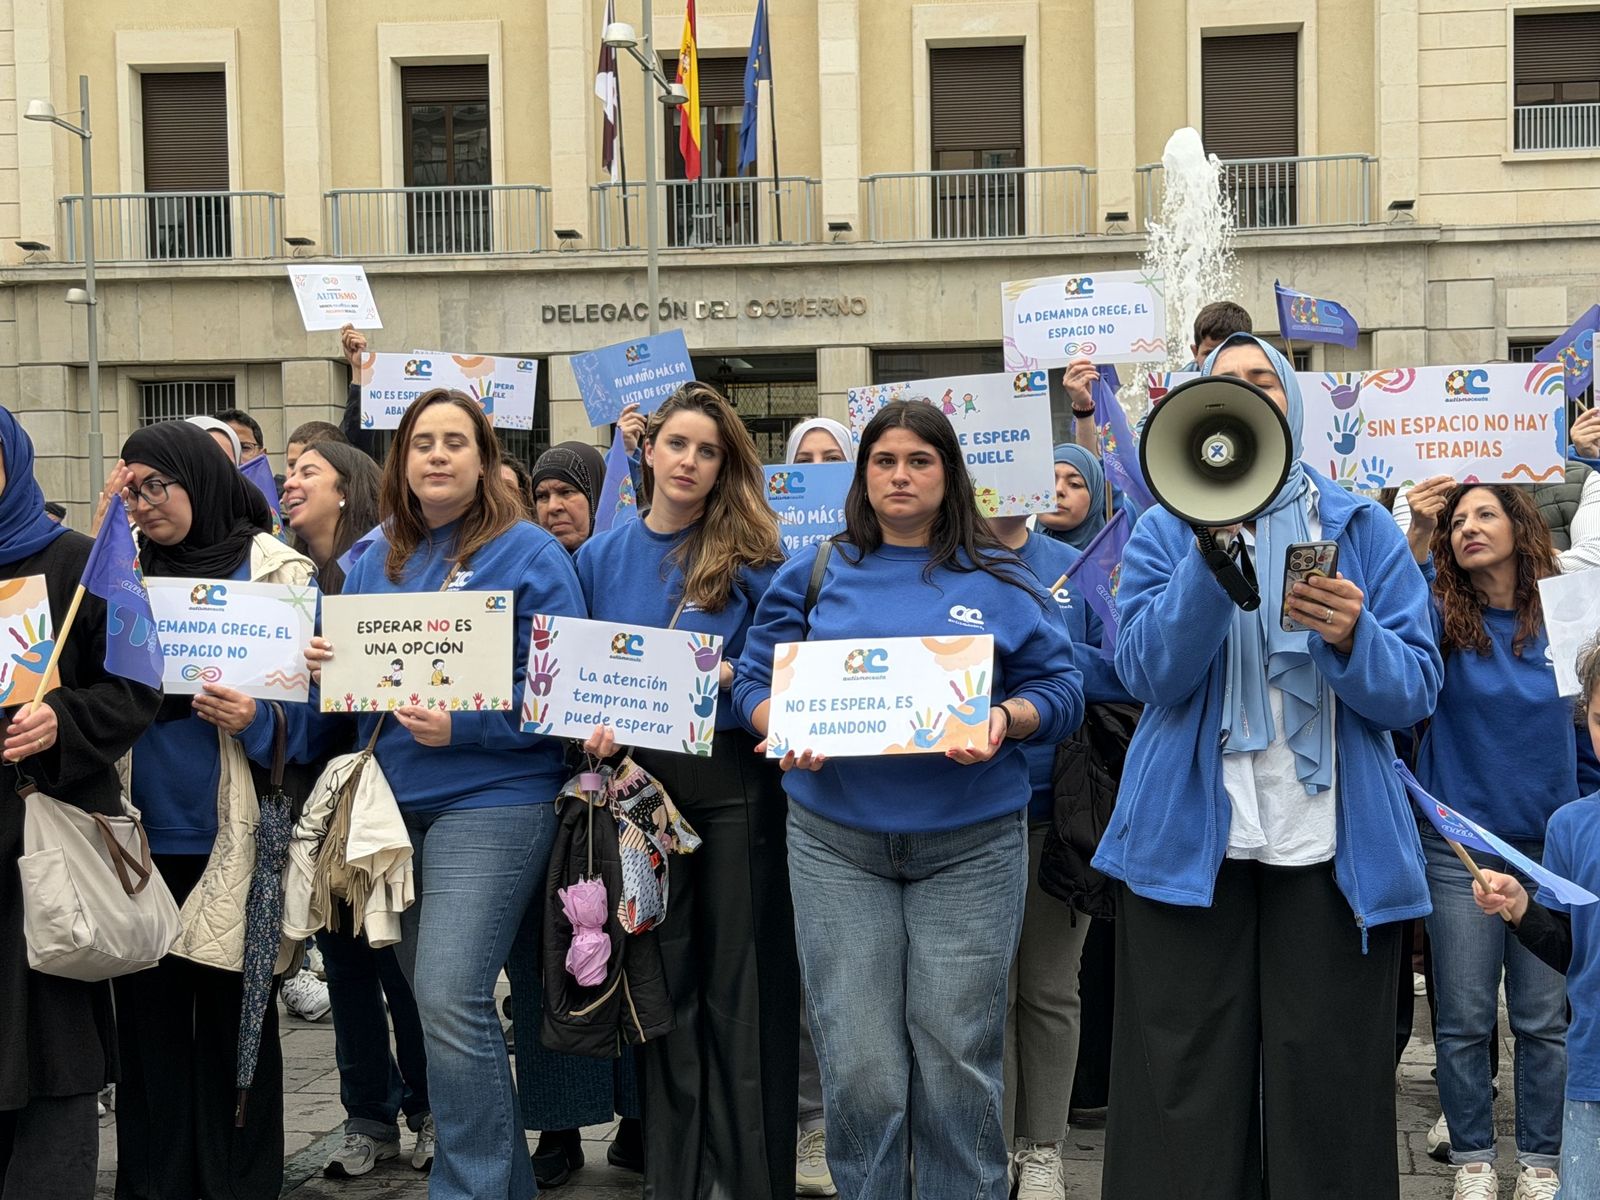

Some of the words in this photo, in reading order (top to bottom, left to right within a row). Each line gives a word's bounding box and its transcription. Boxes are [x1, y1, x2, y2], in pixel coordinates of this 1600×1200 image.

[541, 297, 688, 323] DELEGACÓN
[695, 300, 738, 320] DEL
[745, 296, 867, 320] GOBIERNO
[1018, 313, 1031, 324] LA
[1035, 307, 1088, 322] DEMANDA
[1092, 304, 1131, 316] CRECE,
[1134, 303, 1148, 314] EL
[1048, 325, 1095, 339] ESPACIO
[1099, 324, 1115, 334] NO
[656, 363, 675, 378] MÁS
[370, 391, 382, 400] NO
[384, 391, 395, 400] ES
[397, 391, 424, 400] ESPE
[621, 391, 644, 405] LISTA
[644, 389, 655, 399] DE
[1367, 418, 1396, 437] SIN
[1401, 414, 1479, 435] ESPACIO
[1484, 413, 1509, 431] NO
[1514, 413, 1548, 431] HAY
[973, 429, 1030, 445] ESPERA
[967, 450, 1014, 465] DUELE
[1415, 440, 1503, 460] TERAPIAS
[808, 505, 835, 524] MÁS
[783, 534, 799, 550] DE
[158, 620, 216, 634] EMANDA
[221, 622, 271, 639] CRECE,
[275, 626, 292, 639] EL
[357, 620, 423, 634] ESPERAR
[427, 619, 450, 632] NO
[455, 619, 472, 632] ES
[163, 644, 222, 658] ESPACIO
[227, 646, 248, 659] NO
[364, 642, 397, 655] UNA
[402, 637, 464, 655] OPCIÓN
[579, 667, 597, 682] La
[603, 672, 668, 691] atención
[573, 687, 648, 710] temprana
[653, 703, 669, 713] no
[785, 699, 805, 713] NO
[809, 698, 827, 711] ES
[830, 696, 891, 711] ESPERA,
[895, 695, 913, 709] ES
[564, 710, 610, 727] puede
[615, 716, 673, 735] esperar
[809, 719, 887, 736] ABANDONO
